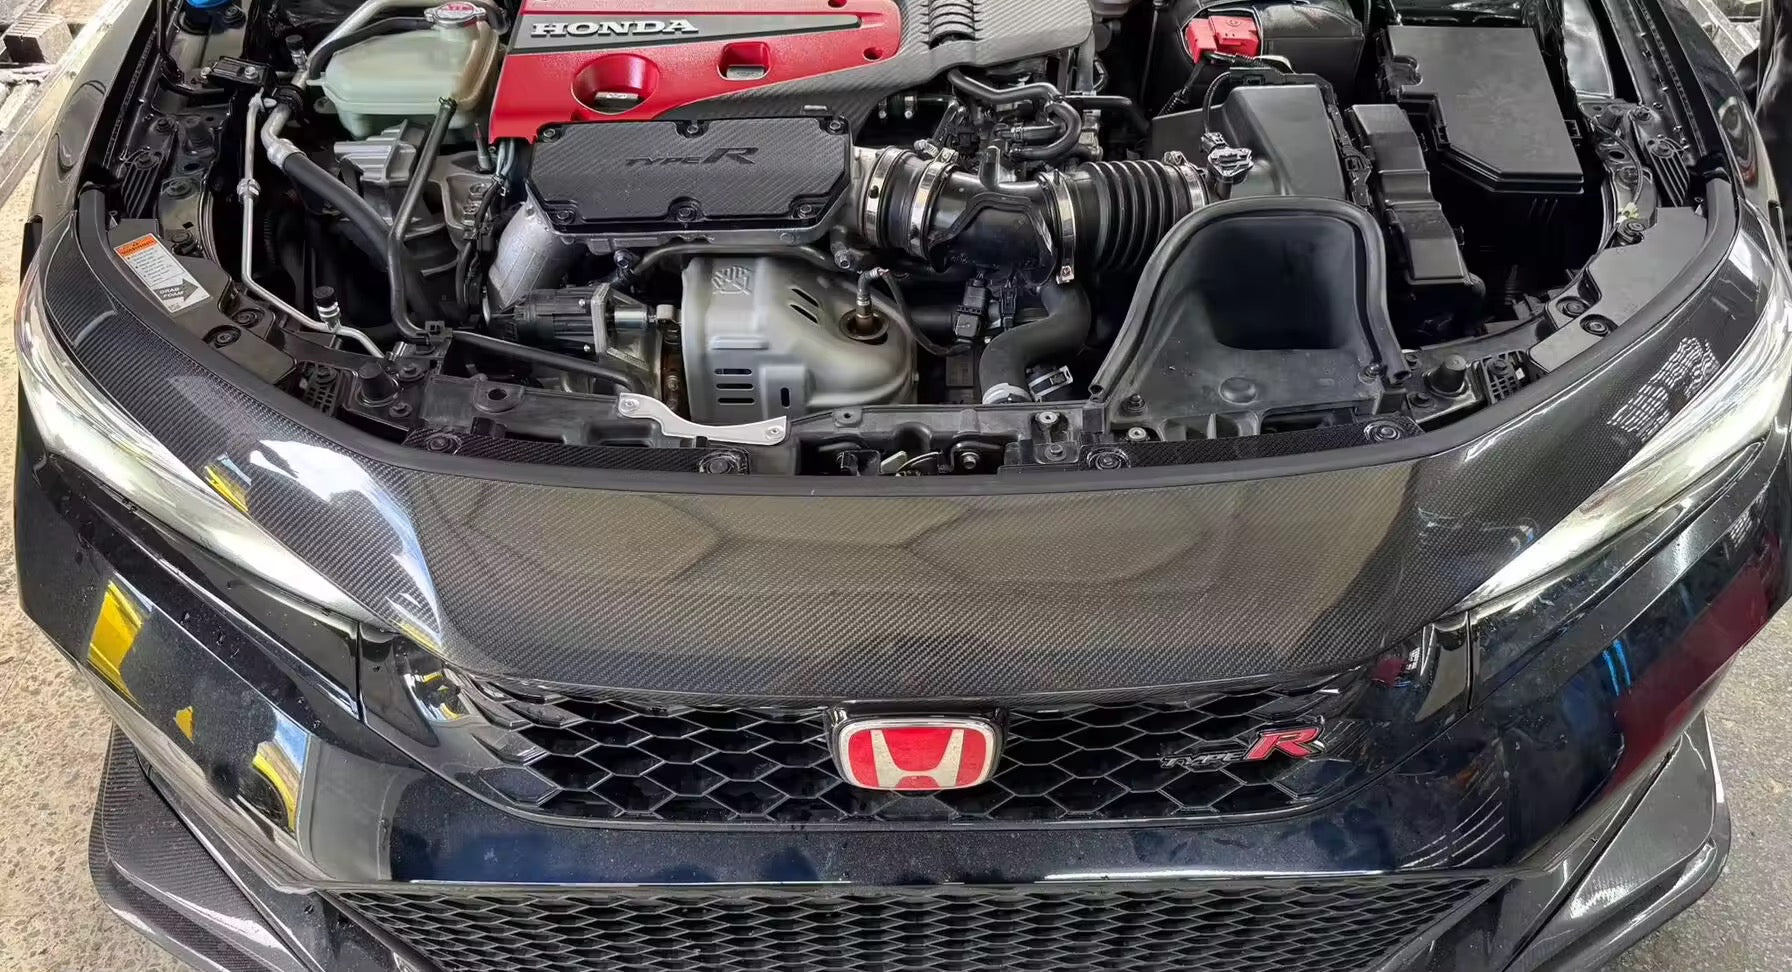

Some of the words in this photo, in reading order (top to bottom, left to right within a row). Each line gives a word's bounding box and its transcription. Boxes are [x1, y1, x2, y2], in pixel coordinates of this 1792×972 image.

[531, 19, 699, 37] HONDA
[625, 156, 703, 166] TYPE
[702, 147, 759, 164] R
[1160, 751, 1247, 769] TYPE
[1244, 726, 1324, 761] R
